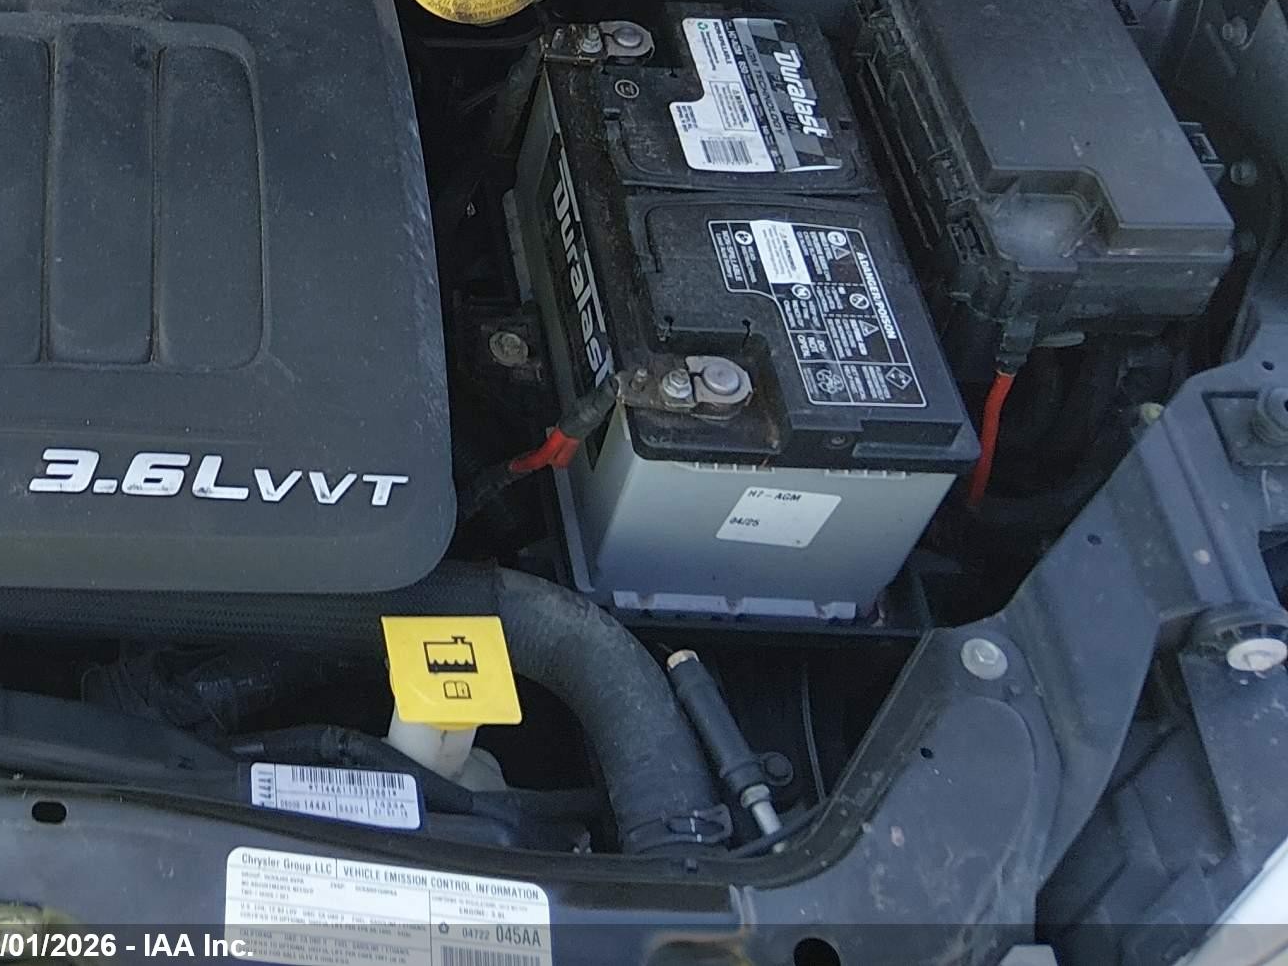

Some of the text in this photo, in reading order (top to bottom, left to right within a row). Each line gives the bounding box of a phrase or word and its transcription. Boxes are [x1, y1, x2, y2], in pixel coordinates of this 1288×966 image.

[752, 69, 785, 135] TECHNOLOGY
[773, 49, 828, 138] Duralast
[552, 180, 613, 389] Duralast
[858, 260, 897, 339] DANGER/POISON
[254, 468, 409, 506] VVT
[774, 491, 801, 503] AGM
[240, 852, 333, 874] Chrysler Group LLC
[342, 865, 540, 900] VEHICLE EMISSION CONTROL INFORMATION
[494, 923, 543, 947] 045AA
